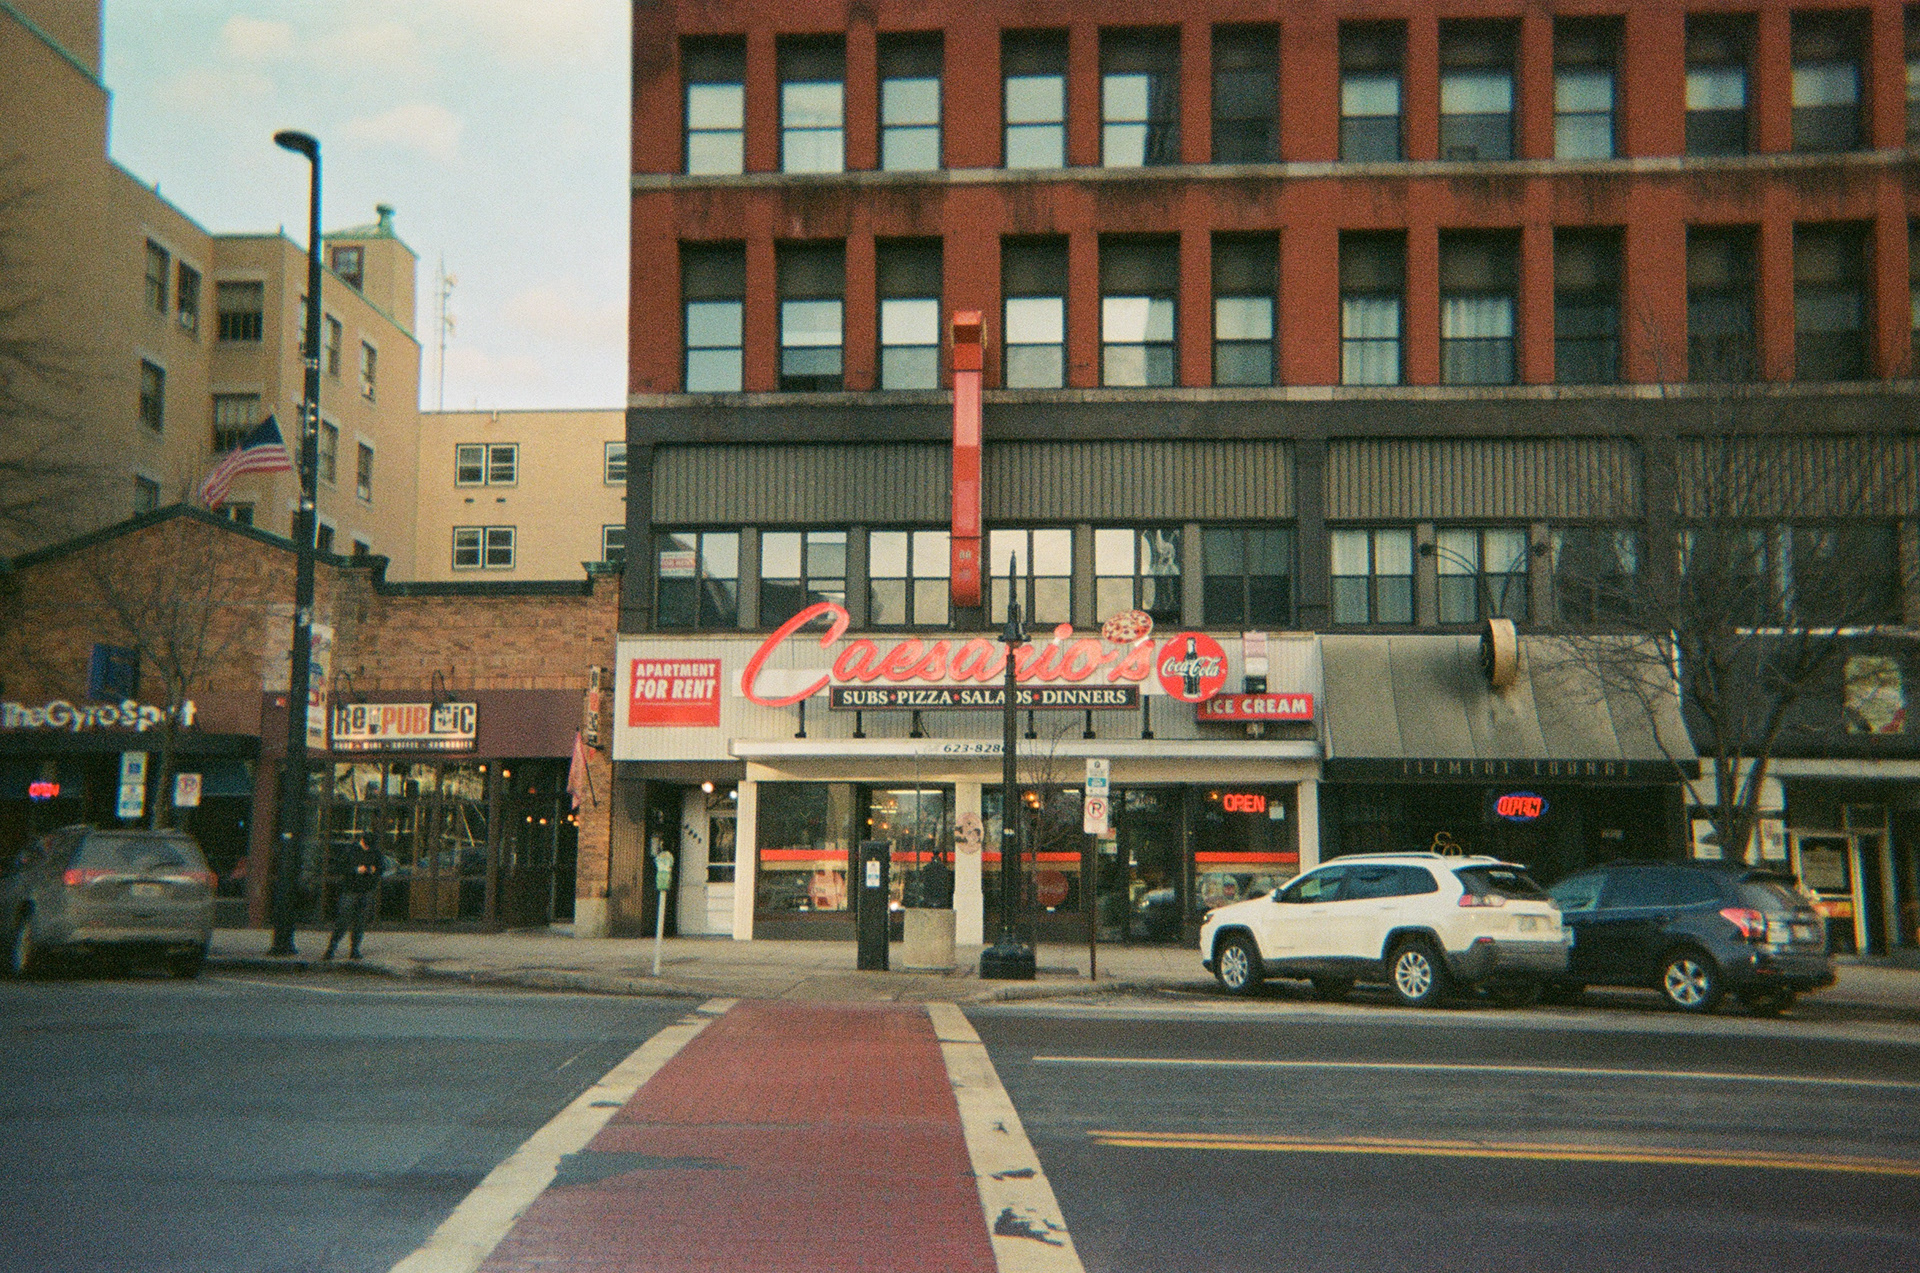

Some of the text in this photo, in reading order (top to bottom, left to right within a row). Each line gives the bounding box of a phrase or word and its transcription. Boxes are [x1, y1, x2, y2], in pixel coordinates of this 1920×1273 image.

[636, 663, 715, 677] APARTMENT
[634, 679, 716, 699] FOR RENT
[843, 690, 888, 705] SUBS
[897, 690, 952, 705] PIZZA
[1042, 690, 1126, 704] DINNERS
[1206, 698, 1307, 714] ICE CREAM
[943, 744, 1006, 753] 623-828
[1223, 794, 1266, 812] OPEN
[1497, 796, 1541, 817] OPEN
